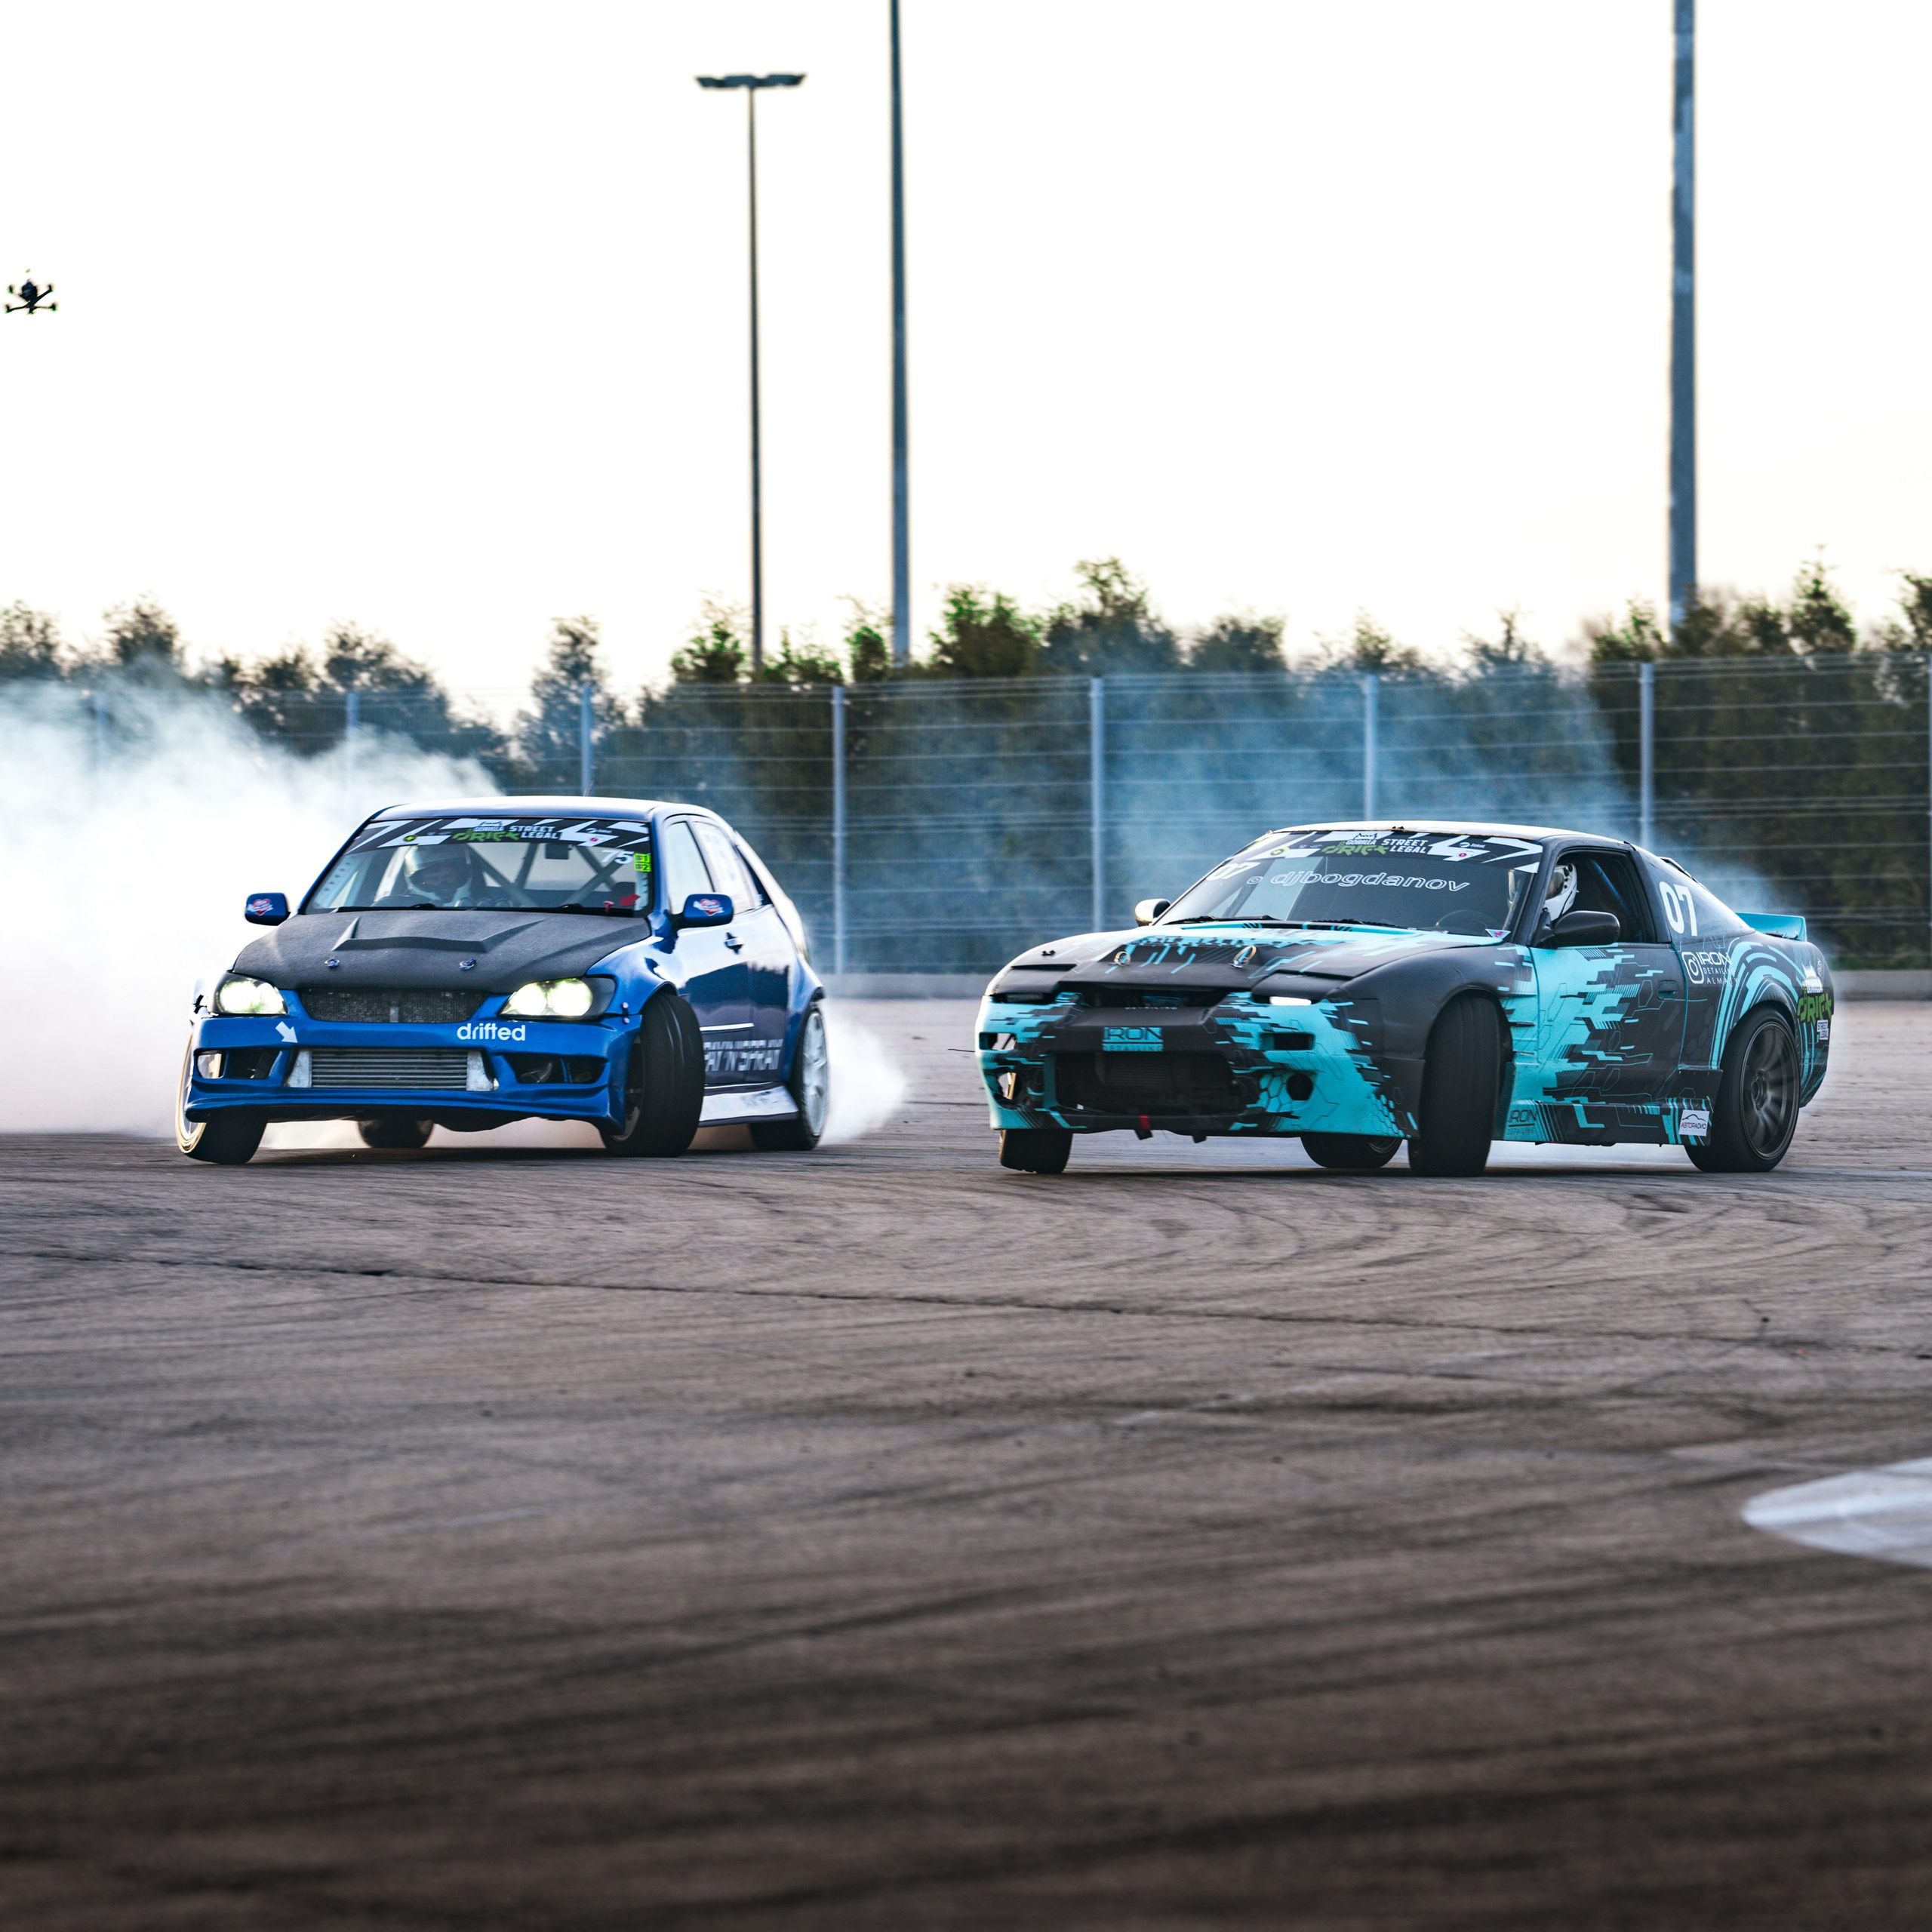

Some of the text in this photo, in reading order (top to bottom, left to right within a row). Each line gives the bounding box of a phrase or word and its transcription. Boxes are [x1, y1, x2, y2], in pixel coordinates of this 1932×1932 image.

[1381, 838, 1428, 847] STREET
[601, 850, 634, 864] 75
[1659, 881, 1697, 937] 07
[1696, 952, 1732, 965] IRON
[457, 1023, 526, 1041] drifted
